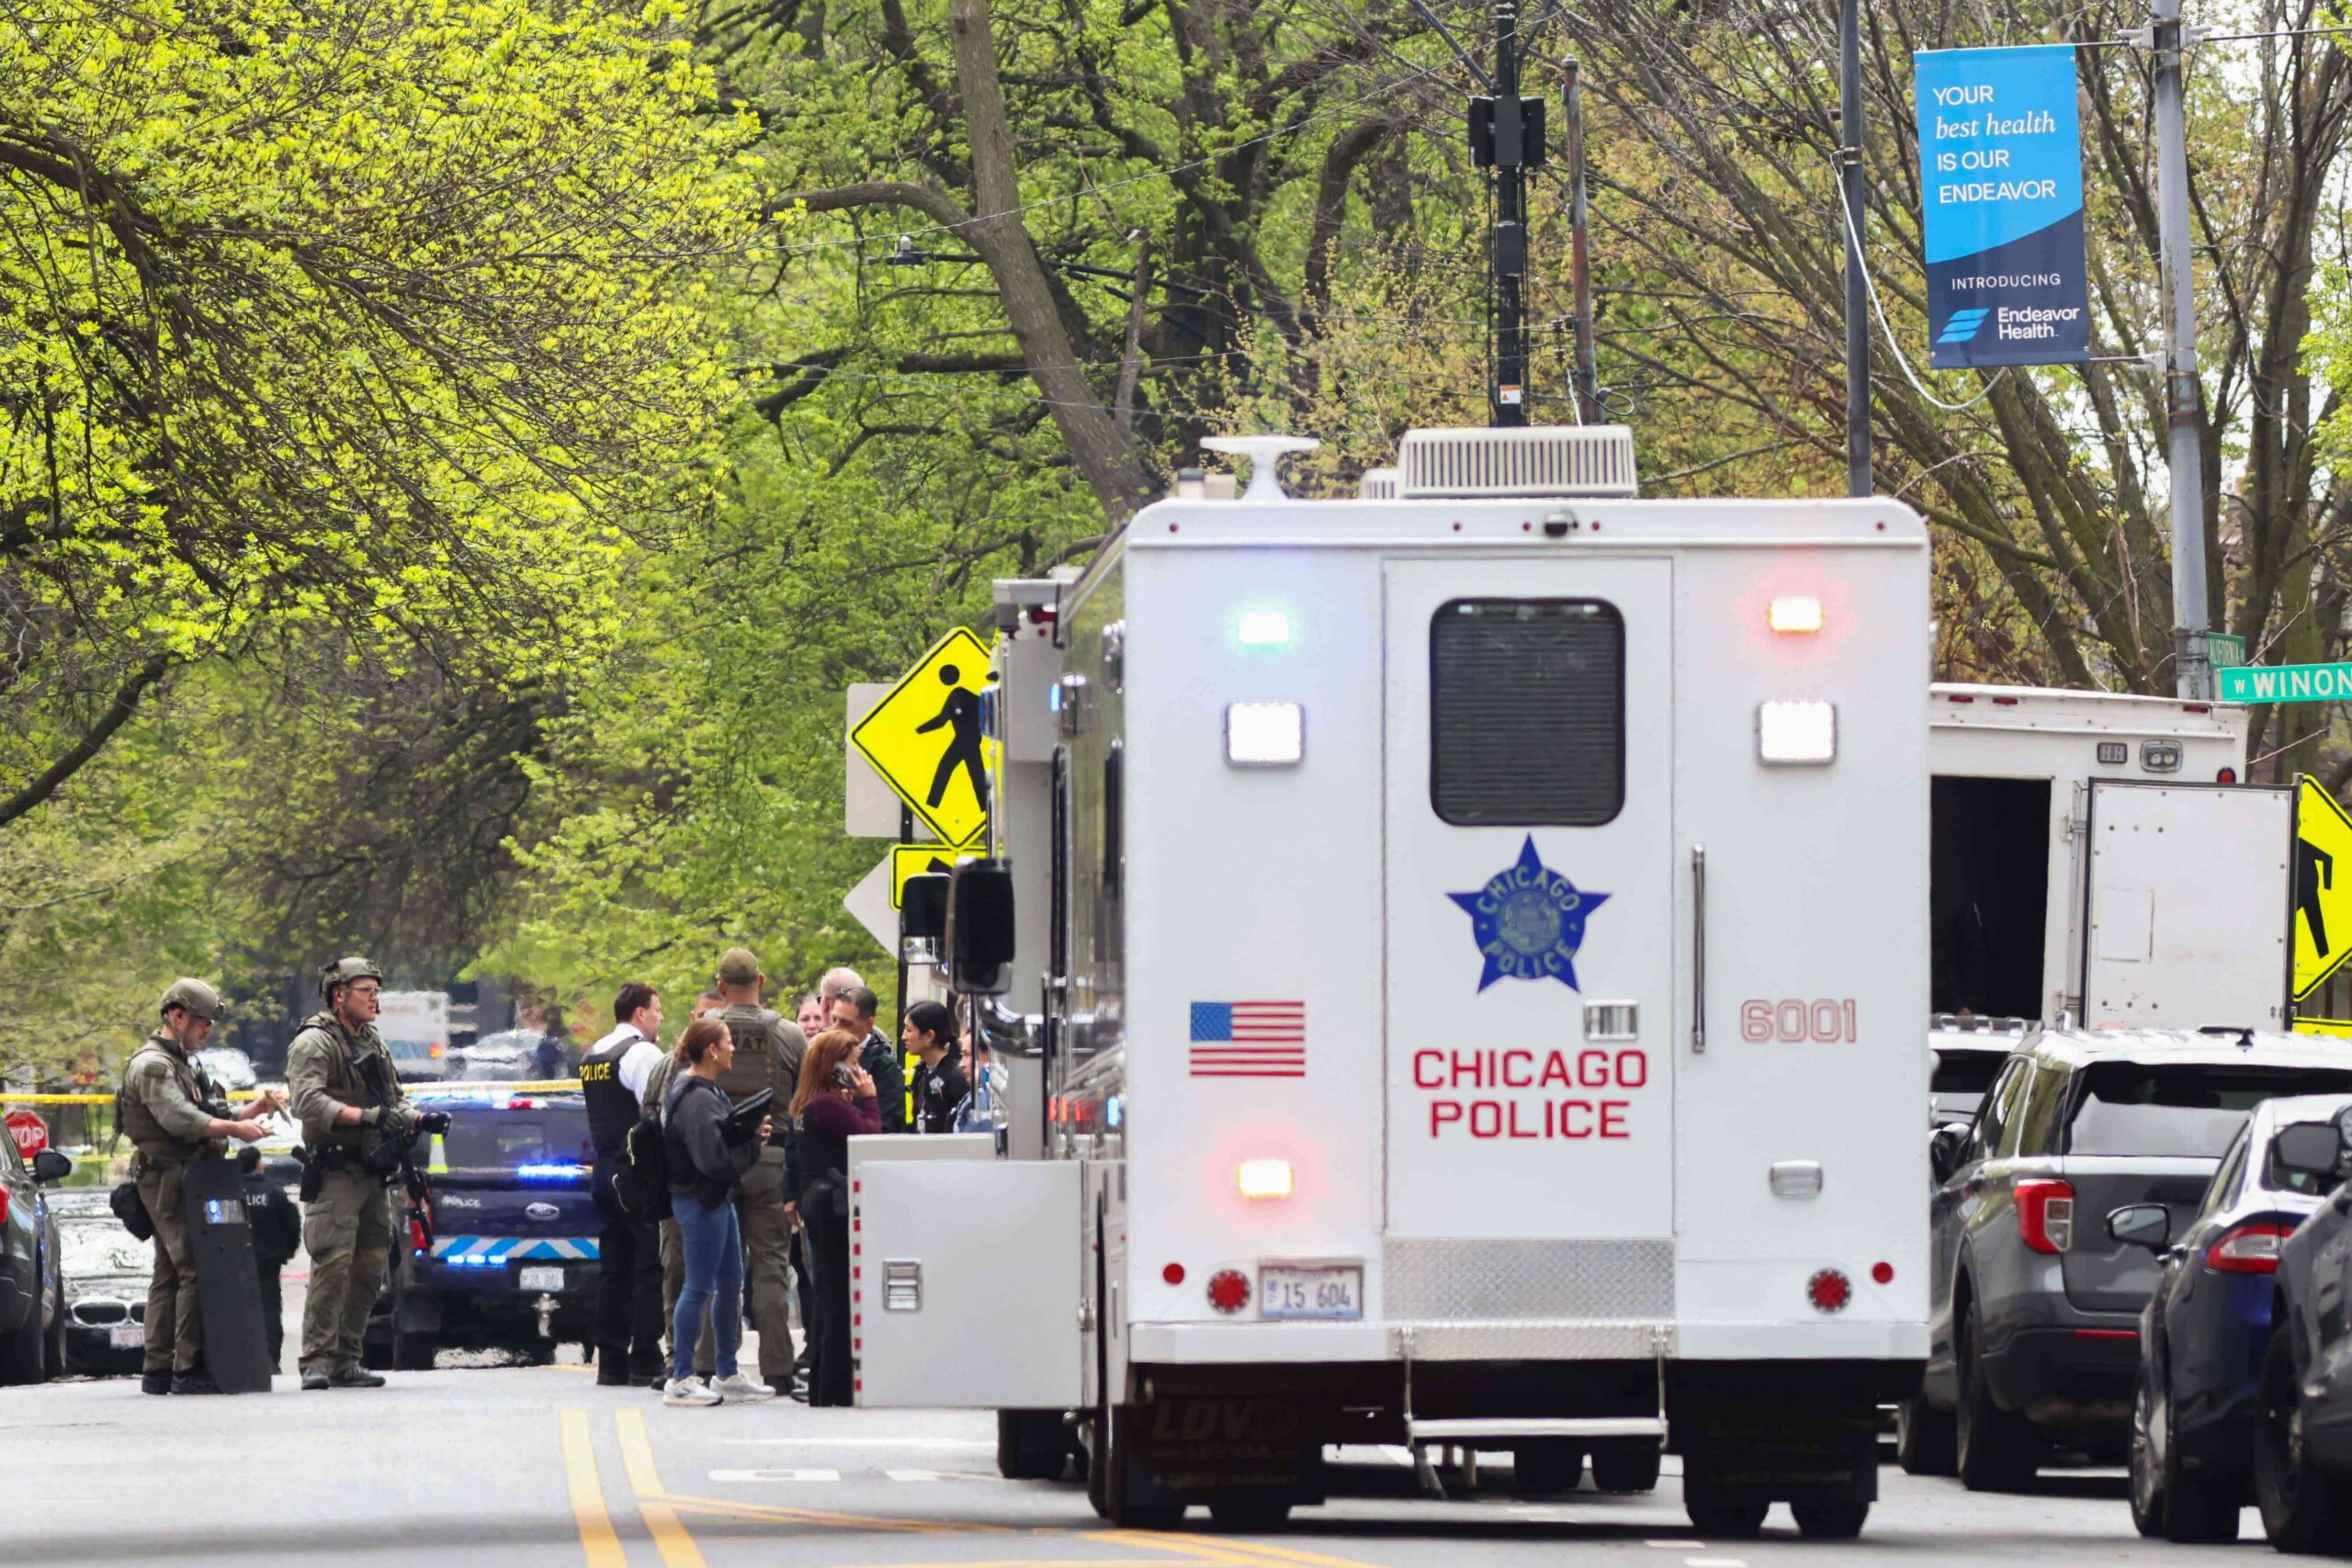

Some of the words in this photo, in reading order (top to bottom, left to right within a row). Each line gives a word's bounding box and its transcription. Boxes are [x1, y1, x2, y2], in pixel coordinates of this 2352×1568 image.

[1933, 85, 1995, 107] YOUR
[1936, 116, 1980, 140] best
[1985, 110, 2056, 136] health
[1937, 152, 1957, 172] IS
[1962, 149, 2010, 170] OUR
[1939, 179, 2057, 204] ENDEAVOR
[1951, 273, 2062, 290] INTRODUCING
[1997, 306, 2080, 323] Endeavor
[1998, 322, 2056, 340] Health
[2233, 679, 2246, 694] W
[2252, 668, 2352, 699] WINON
[1476, 865, 1581, 915] CHICAGO
[1482, 938, 1576, 978] POLICE
[1740, 998, 1856, 1043] 6001
[731, 1036, 765, 1050] WAT
[579, 1062, 611, 1082] POLICE
[1413, 1049, 1647, 1089] CHICAGO
[1430, 1099, 1631, 1138] POLICE
[8, 1125, 45, 1148] TOP
[246, 1194, 267, 1207] LICE
[1283, 1282, 1306, 1308] 15
[1317, 1282, 1351, 1308] 604
